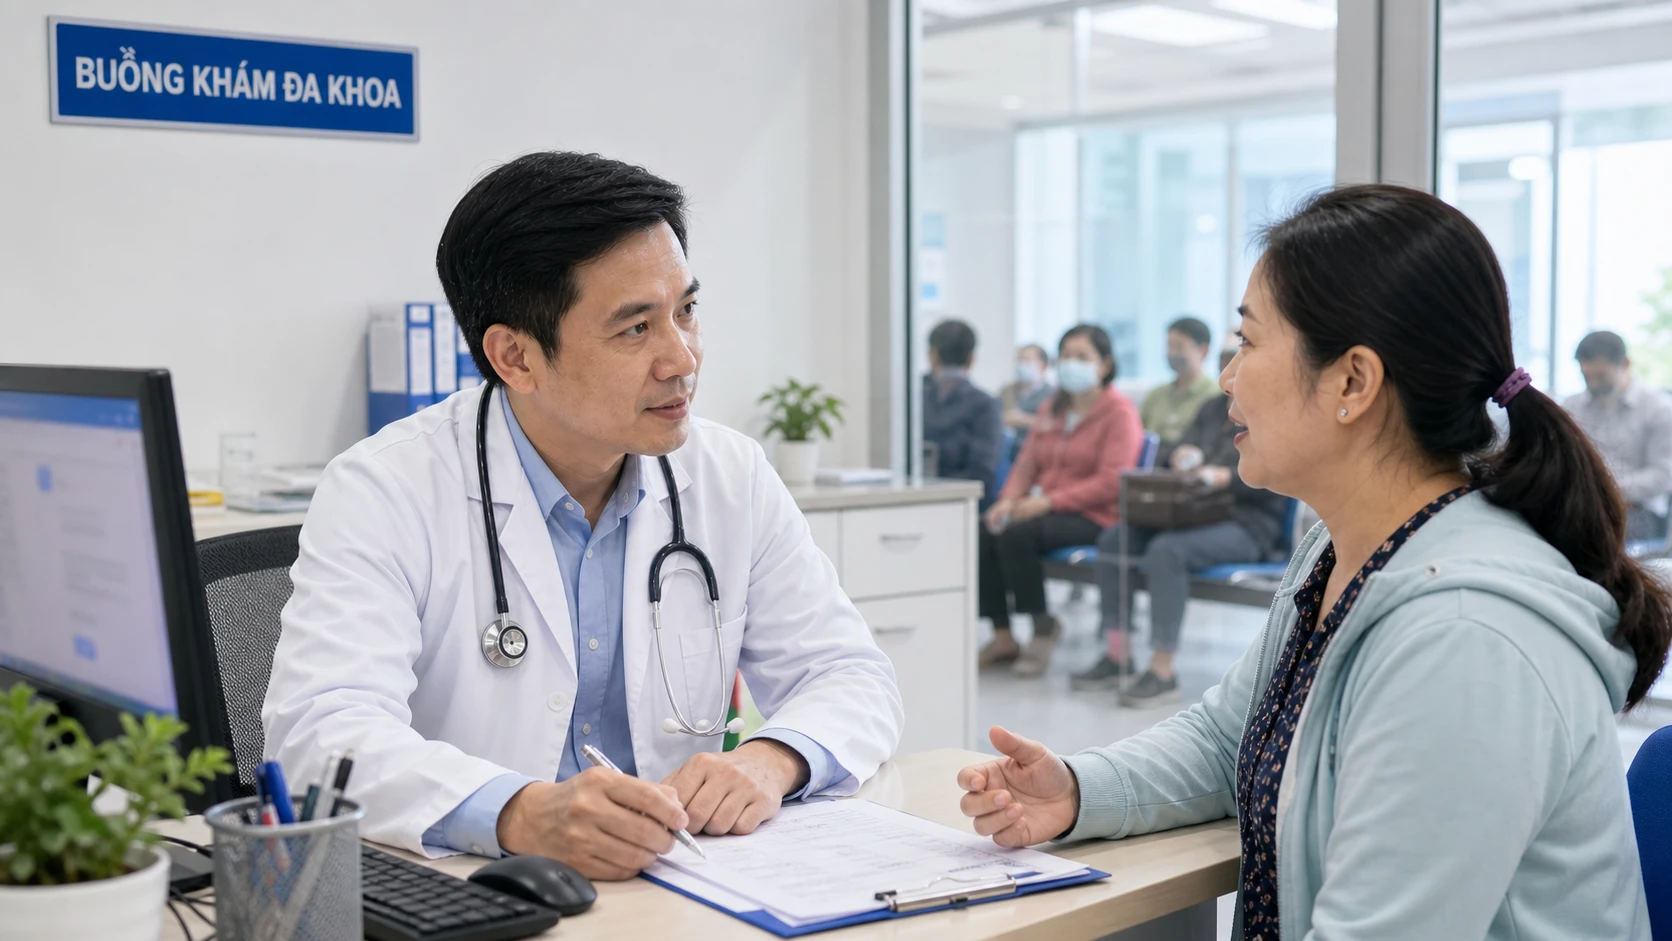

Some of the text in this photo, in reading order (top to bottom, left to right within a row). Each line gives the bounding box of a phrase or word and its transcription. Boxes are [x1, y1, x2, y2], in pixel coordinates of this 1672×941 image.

[193, 60, 276, 101] KHÁM
[282, 71, 322, 104] ĐA
[328, 74, 402, 109] KHOA
